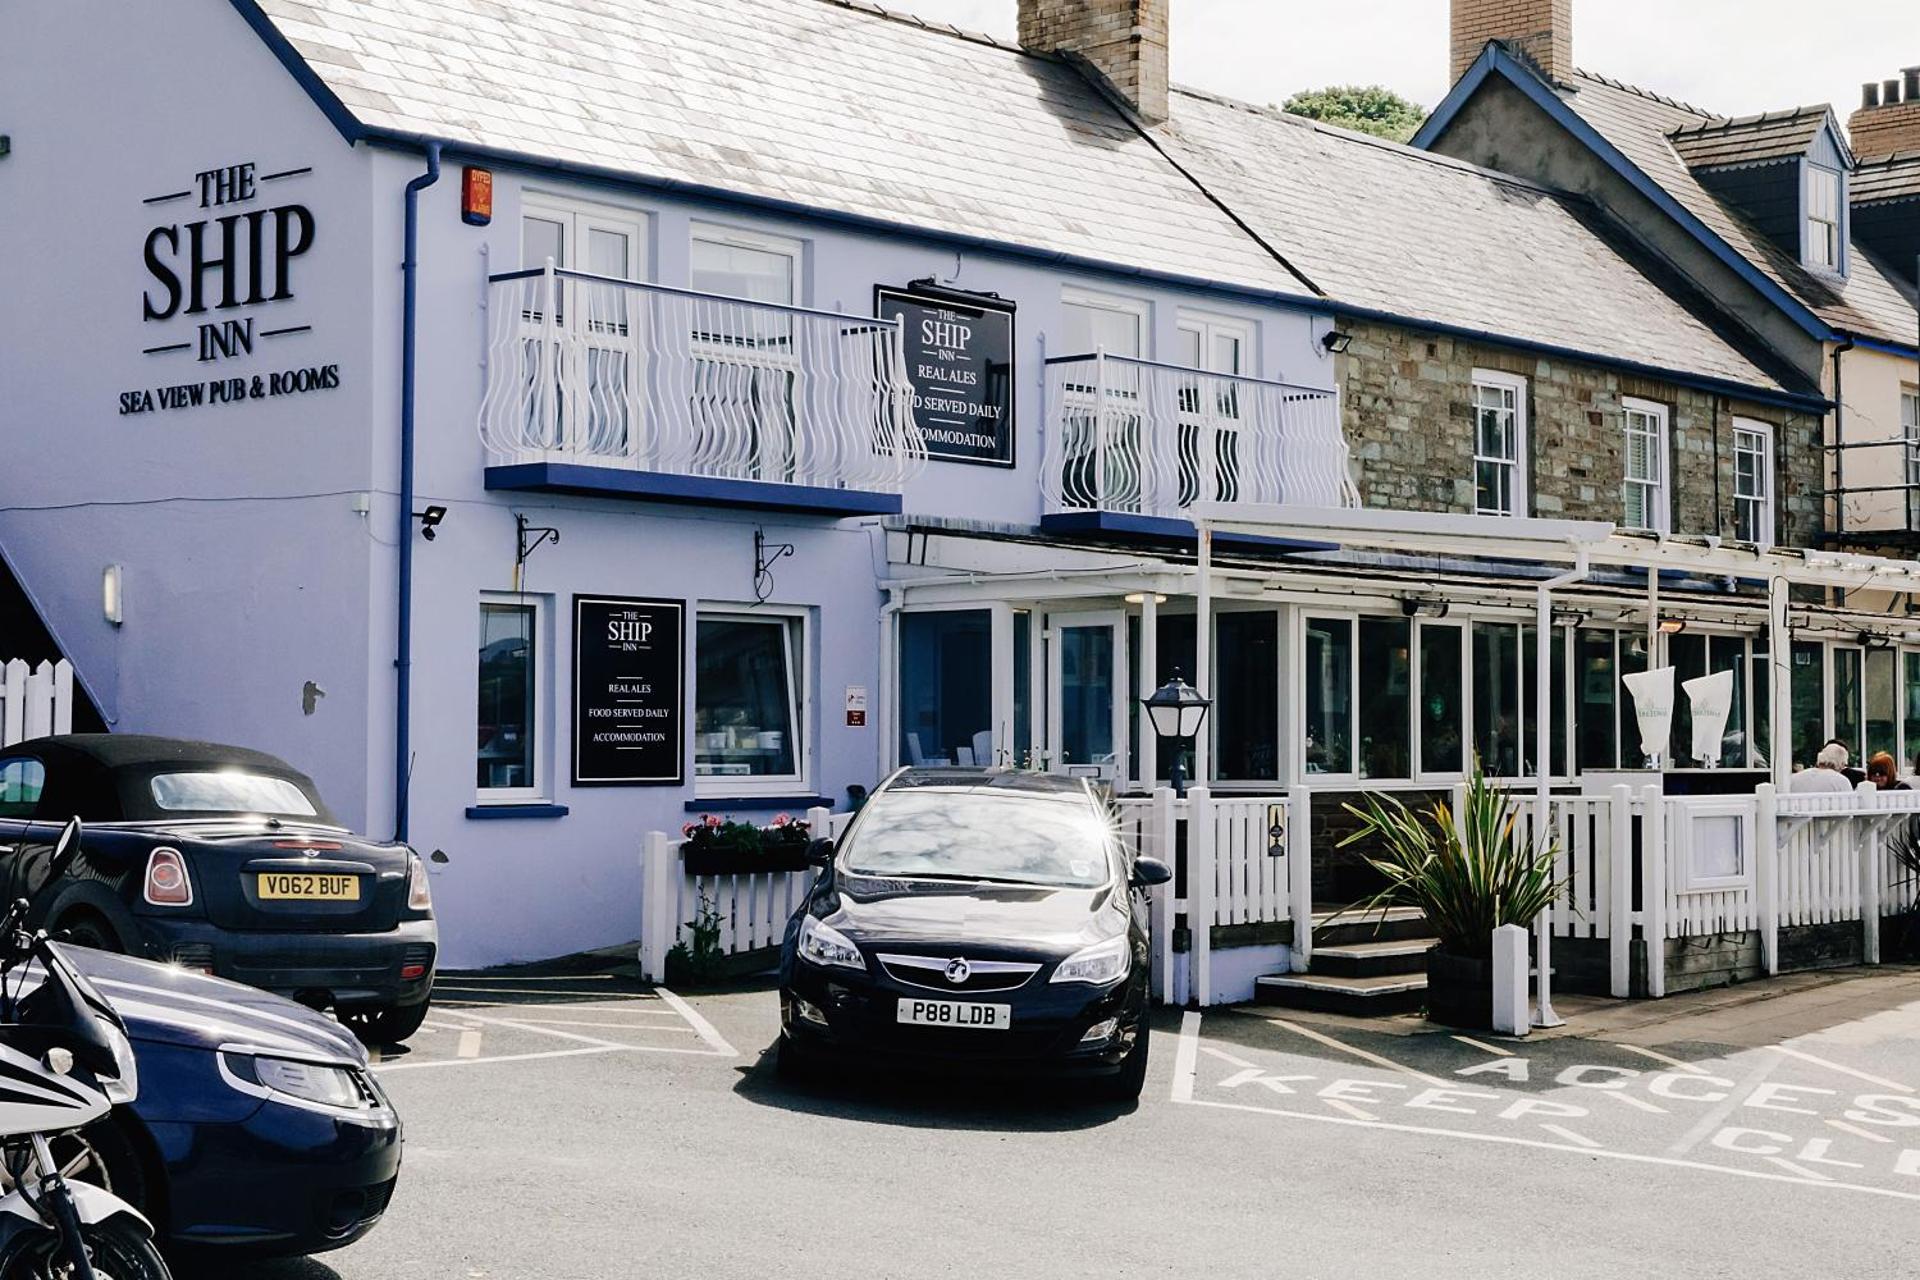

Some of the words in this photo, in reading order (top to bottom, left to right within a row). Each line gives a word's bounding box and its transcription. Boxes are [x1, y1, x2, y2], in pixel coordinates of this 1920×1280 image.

[195, 162, 256, 208] THE
[143, 204, 315, 322] SHIP
[939, 309, 956, 321] THE
[197, 318, 254, 362] INN
[922, 319, 972, 350] SHIP
[938, 349, 955, 361] INN
[918, 364, 947, 382] REAL
[949, 369, 977, 386] ALES
[119, 391, 154, 415] SEA
[157, 382, 205, 411] VIEW
[209, 377, 246, 407] PUB
[249, 375, 266, 400] &
[269, 364, 340, 396] ROOMS
[924, 397, 967, 414] SERVED
[969, 403, 1002, 420] DAILY
[622, 611, 639, 620] THE
[608, 621, 652, 642] SHIP
[622, 642, 637, 651] INN
[608, 684, 631, 693] REAL
[631, 684, 651, 693] ALES
[588, 708, 612, 717] FOOD
[612, 708, 644, 717] SERVED
[645, 708, 669, 717] DAILY
[593, 732, 666, 742] ACCOMMODATION
[267, 876, 313, 895] VO62
[319, 877, 351, 895] BUF
[912, 1002, 951, 1022] P88
[956, 1005, 995, 1025] LDB
[1217, 1069, 1591, 1121] KEEP
